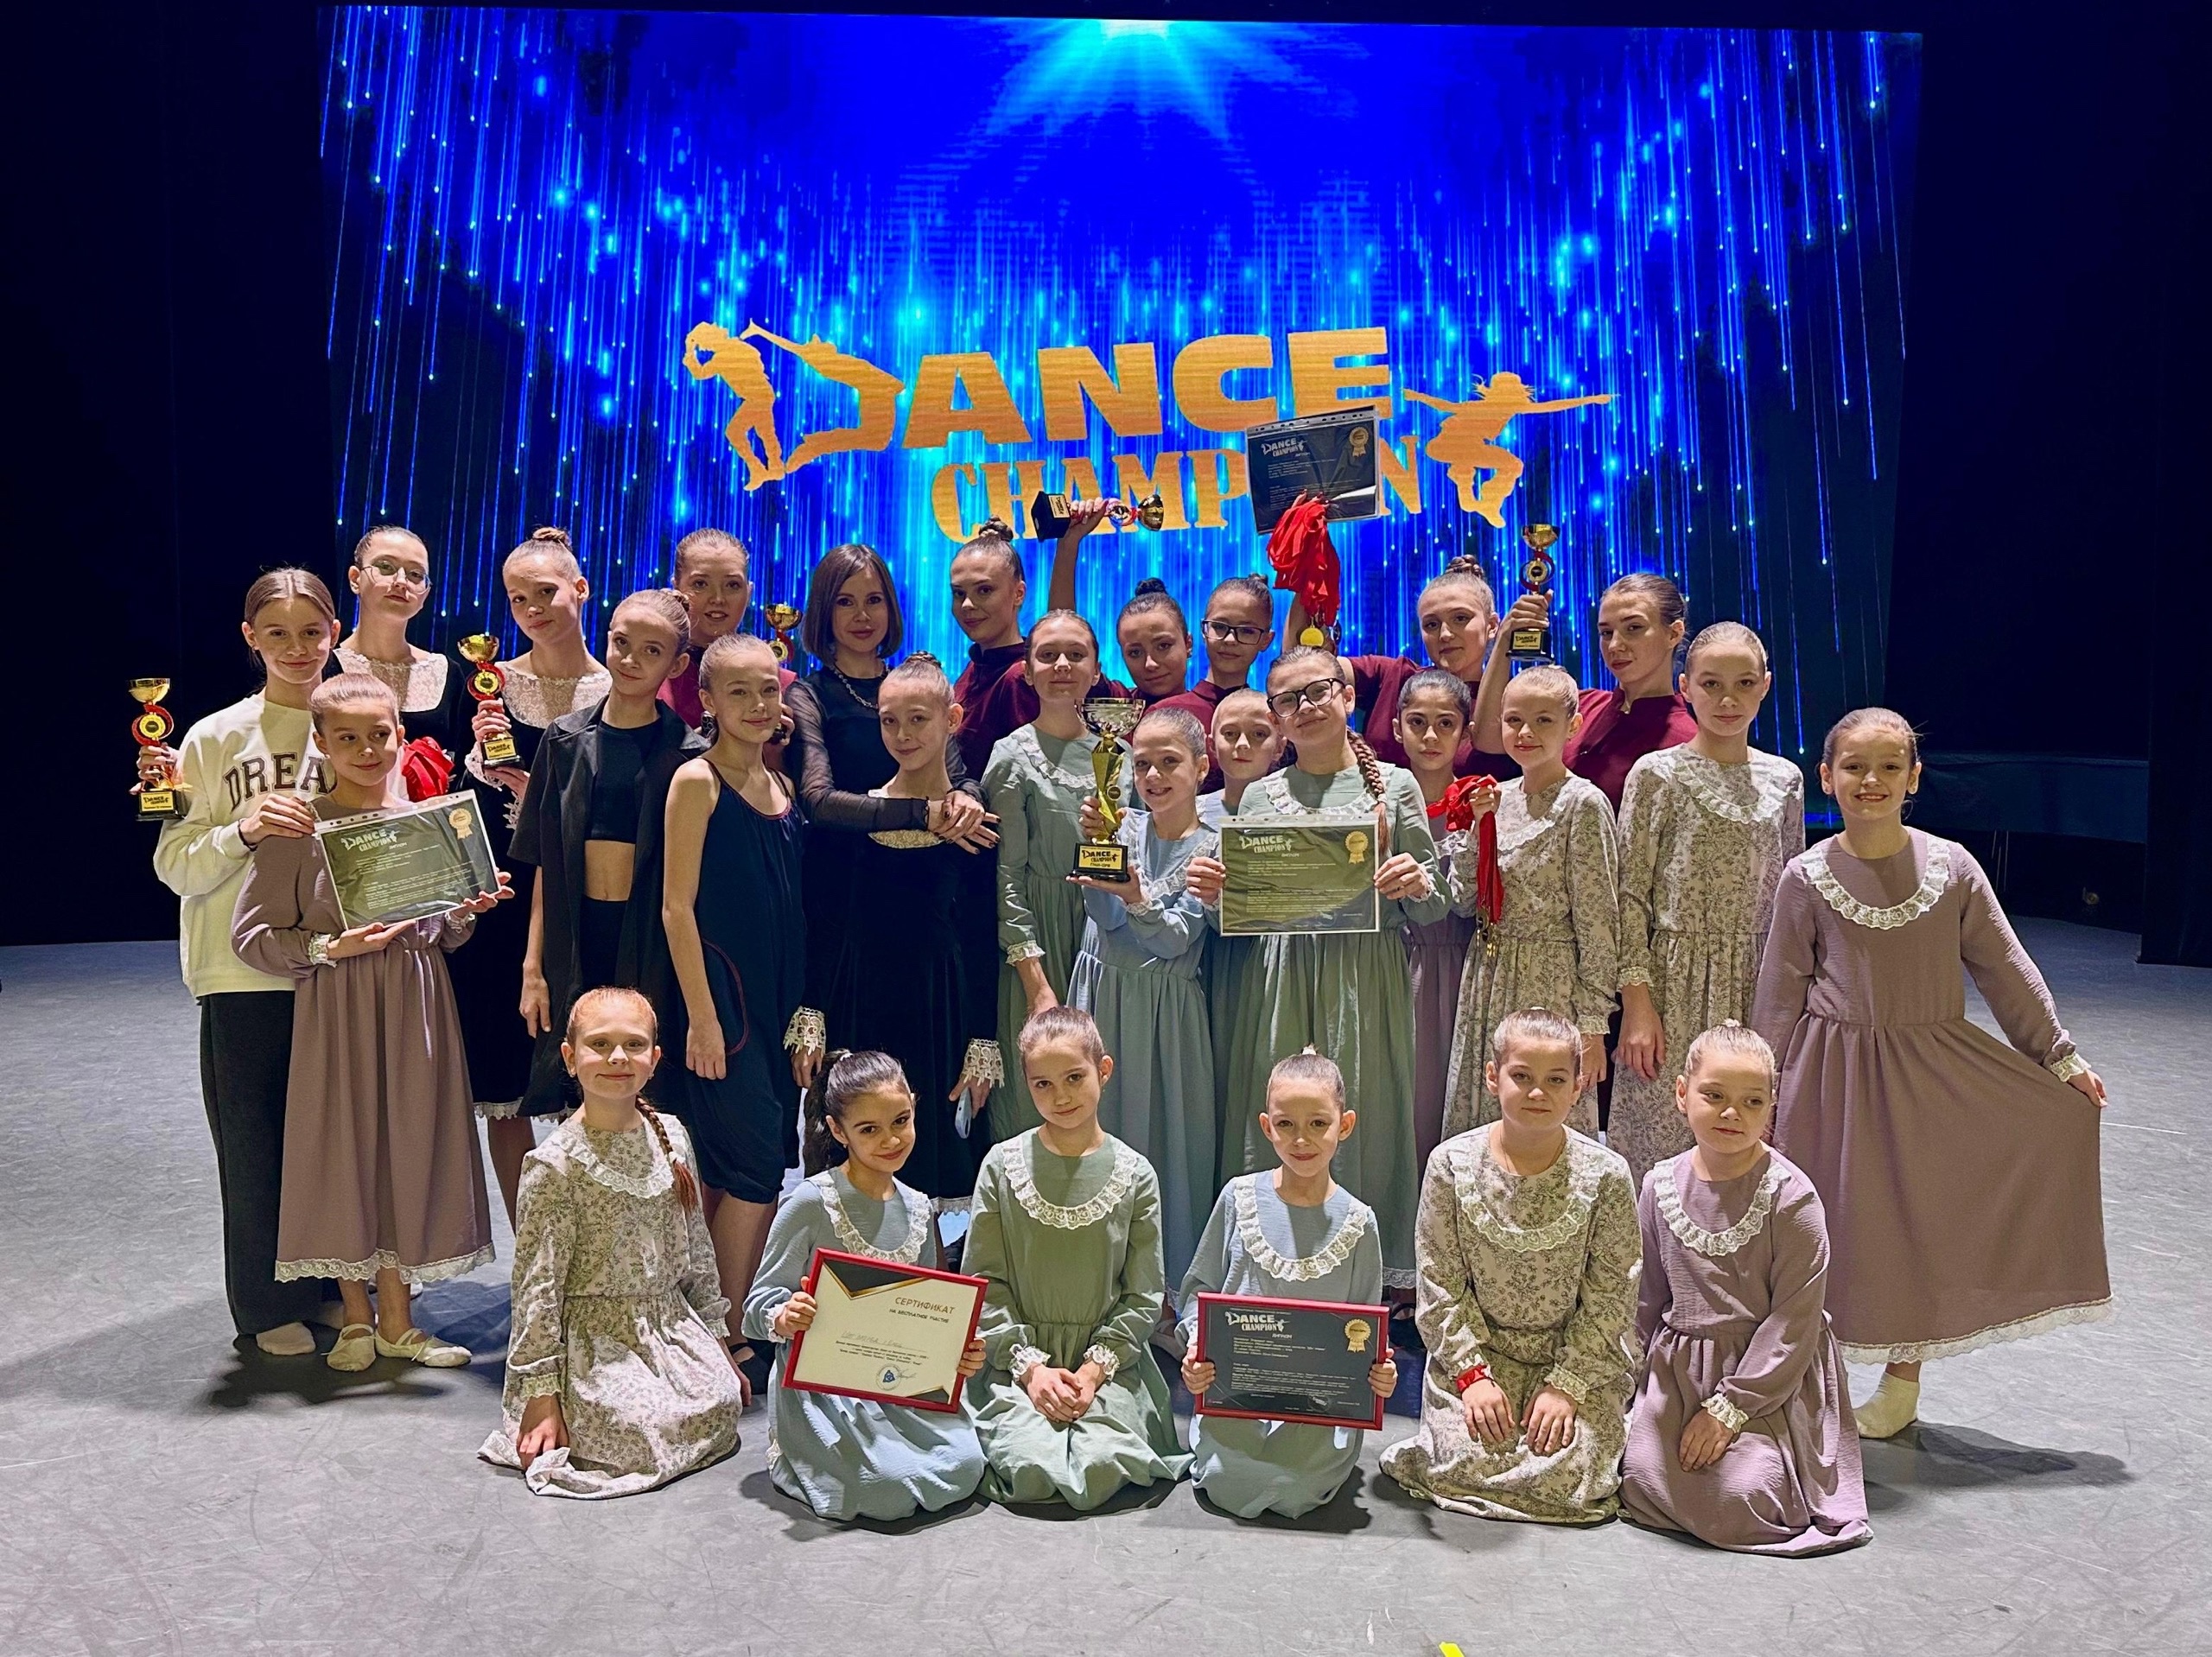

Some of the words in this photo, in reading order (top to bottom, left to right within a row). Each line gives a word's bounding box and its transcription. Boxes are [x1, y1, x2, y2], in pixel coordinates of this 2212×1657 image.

[683, 320, 1392, 491] DANCE
[1261, 438, 1297, 455] DANCE
[931, 435, 1421, 543] CHAMPN
[223, 751, 337, 814] DREA
[340, 828, 387, 851] DANCE
[1238, 835, 1283, 849] DANCE
[1081, 850, 1111, 860] DANCE
[1253, 843, 1286, 854] CHAMPION
[894, 1297, 956, 1315] СЕРТИФИКАТ
[1224, 1311, 1275, 1326] DANCE
[1241, 1322, 1277, 1332] CHAMPION
